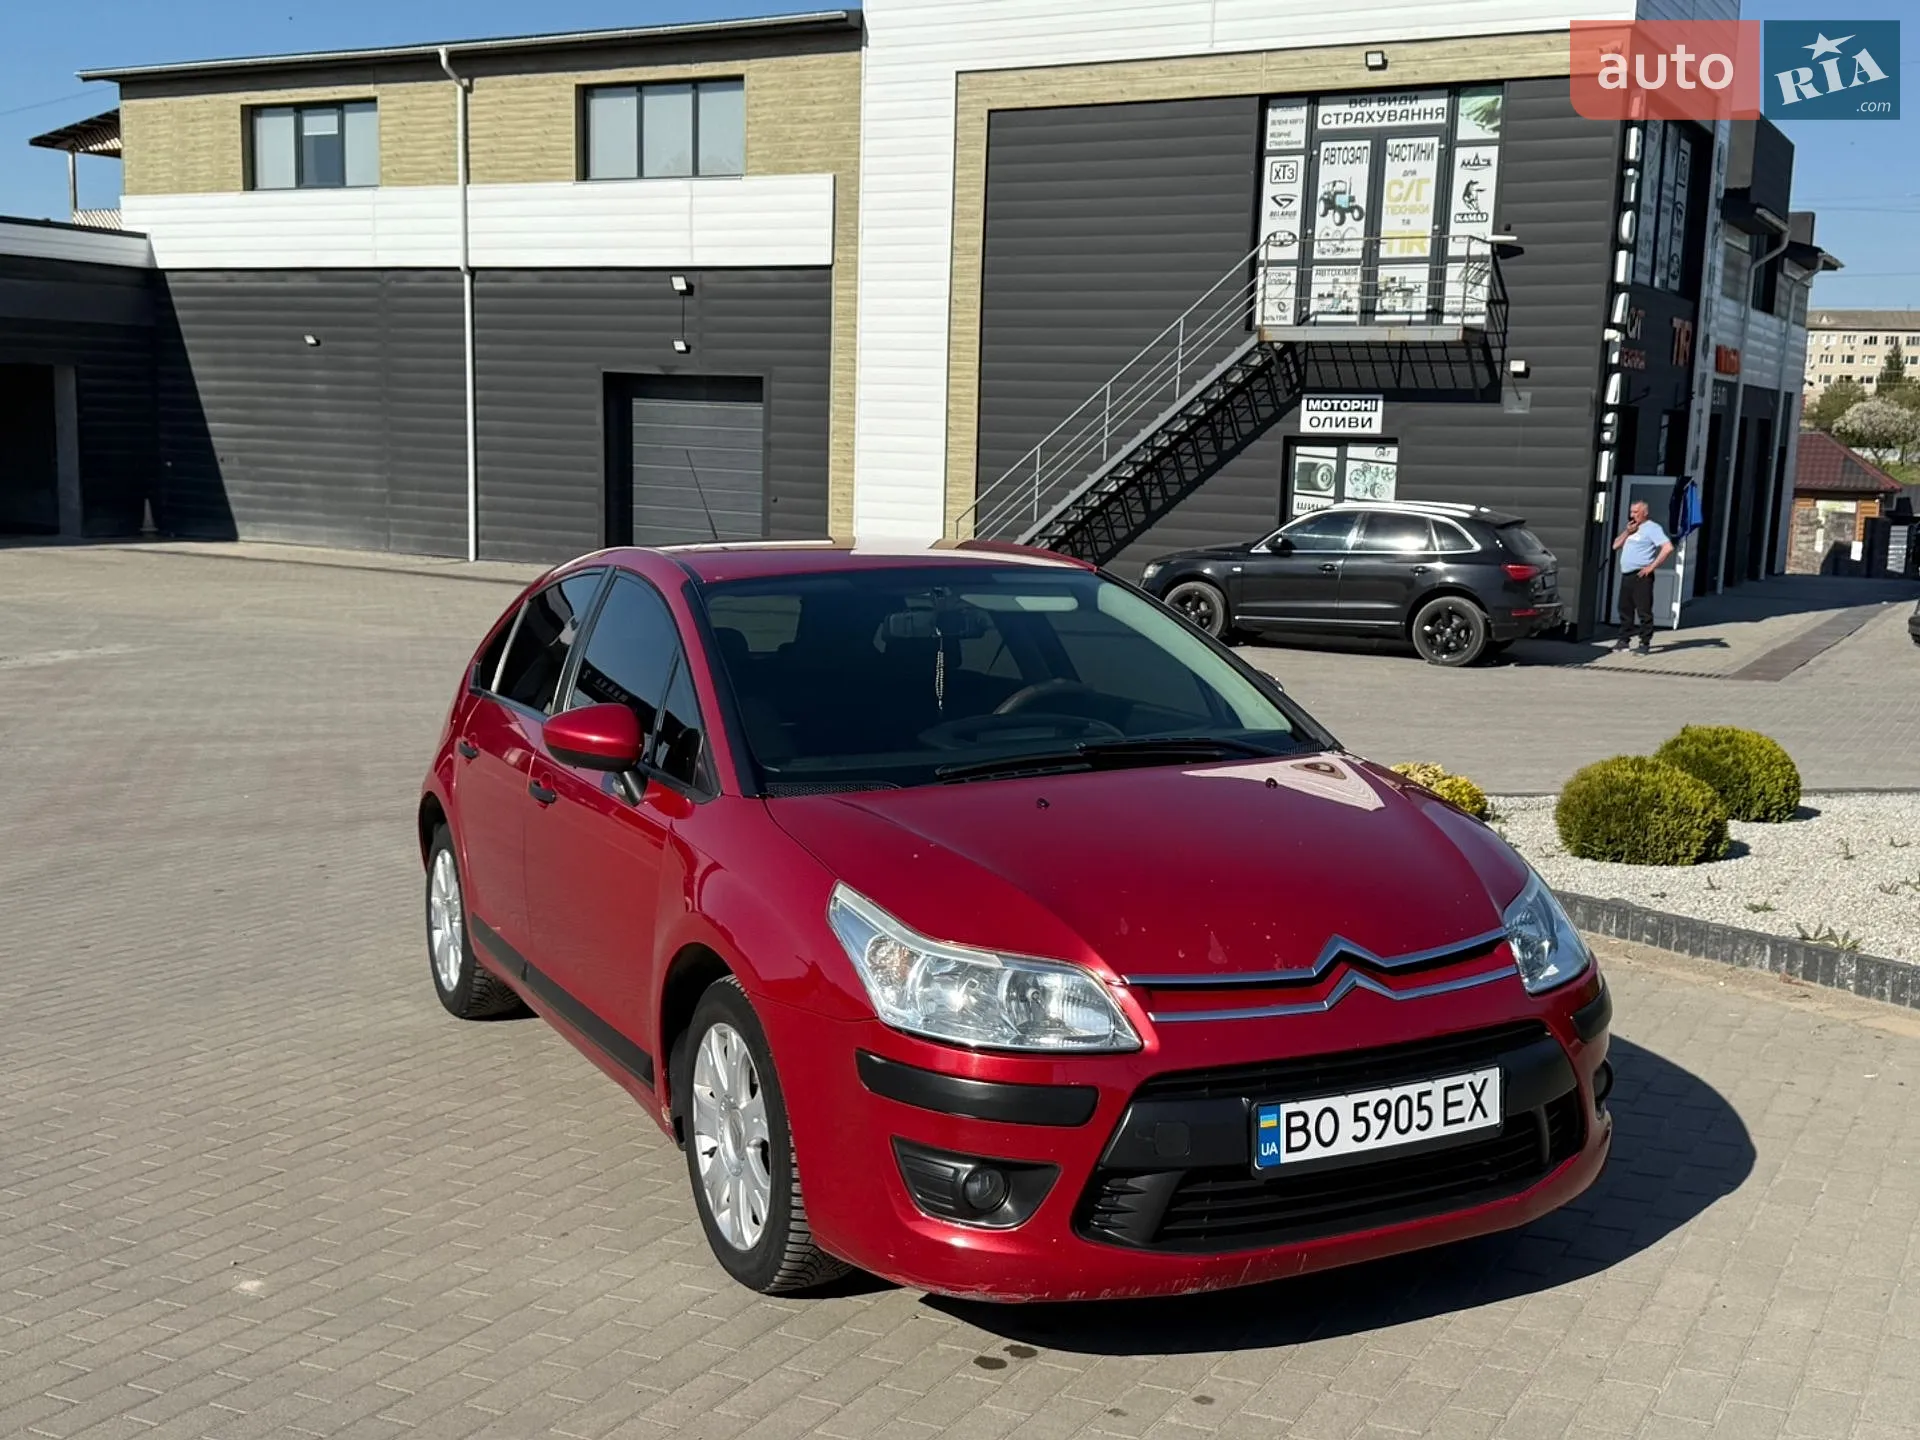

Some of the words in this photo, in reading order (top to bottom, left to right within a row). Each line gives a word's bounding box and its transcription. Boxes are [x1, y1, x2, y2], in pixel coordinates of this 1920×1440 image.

[1377, 94, 1419, 107] ВИДИ
[1321, 106, 1446, 126] СТРАХУВАННЯ
[1322, 145, 1369, 166] АВТОЗАП
[1387, 142, 1435, 163] ЧАСТИНИ
[1386, 178, 1432, 203] С/Г
[1307, 399, 1377, 411] МОТОРНІ
[1309, 416, 1372, 429] ОЛИВИ
[1285, 1106, 1340, 1154] BO
[1352, 1089, 1433, 1143] 5905
[1443, 1077, 1488, 1128] EX
[1261, 1142, 1278, 1156] UA
